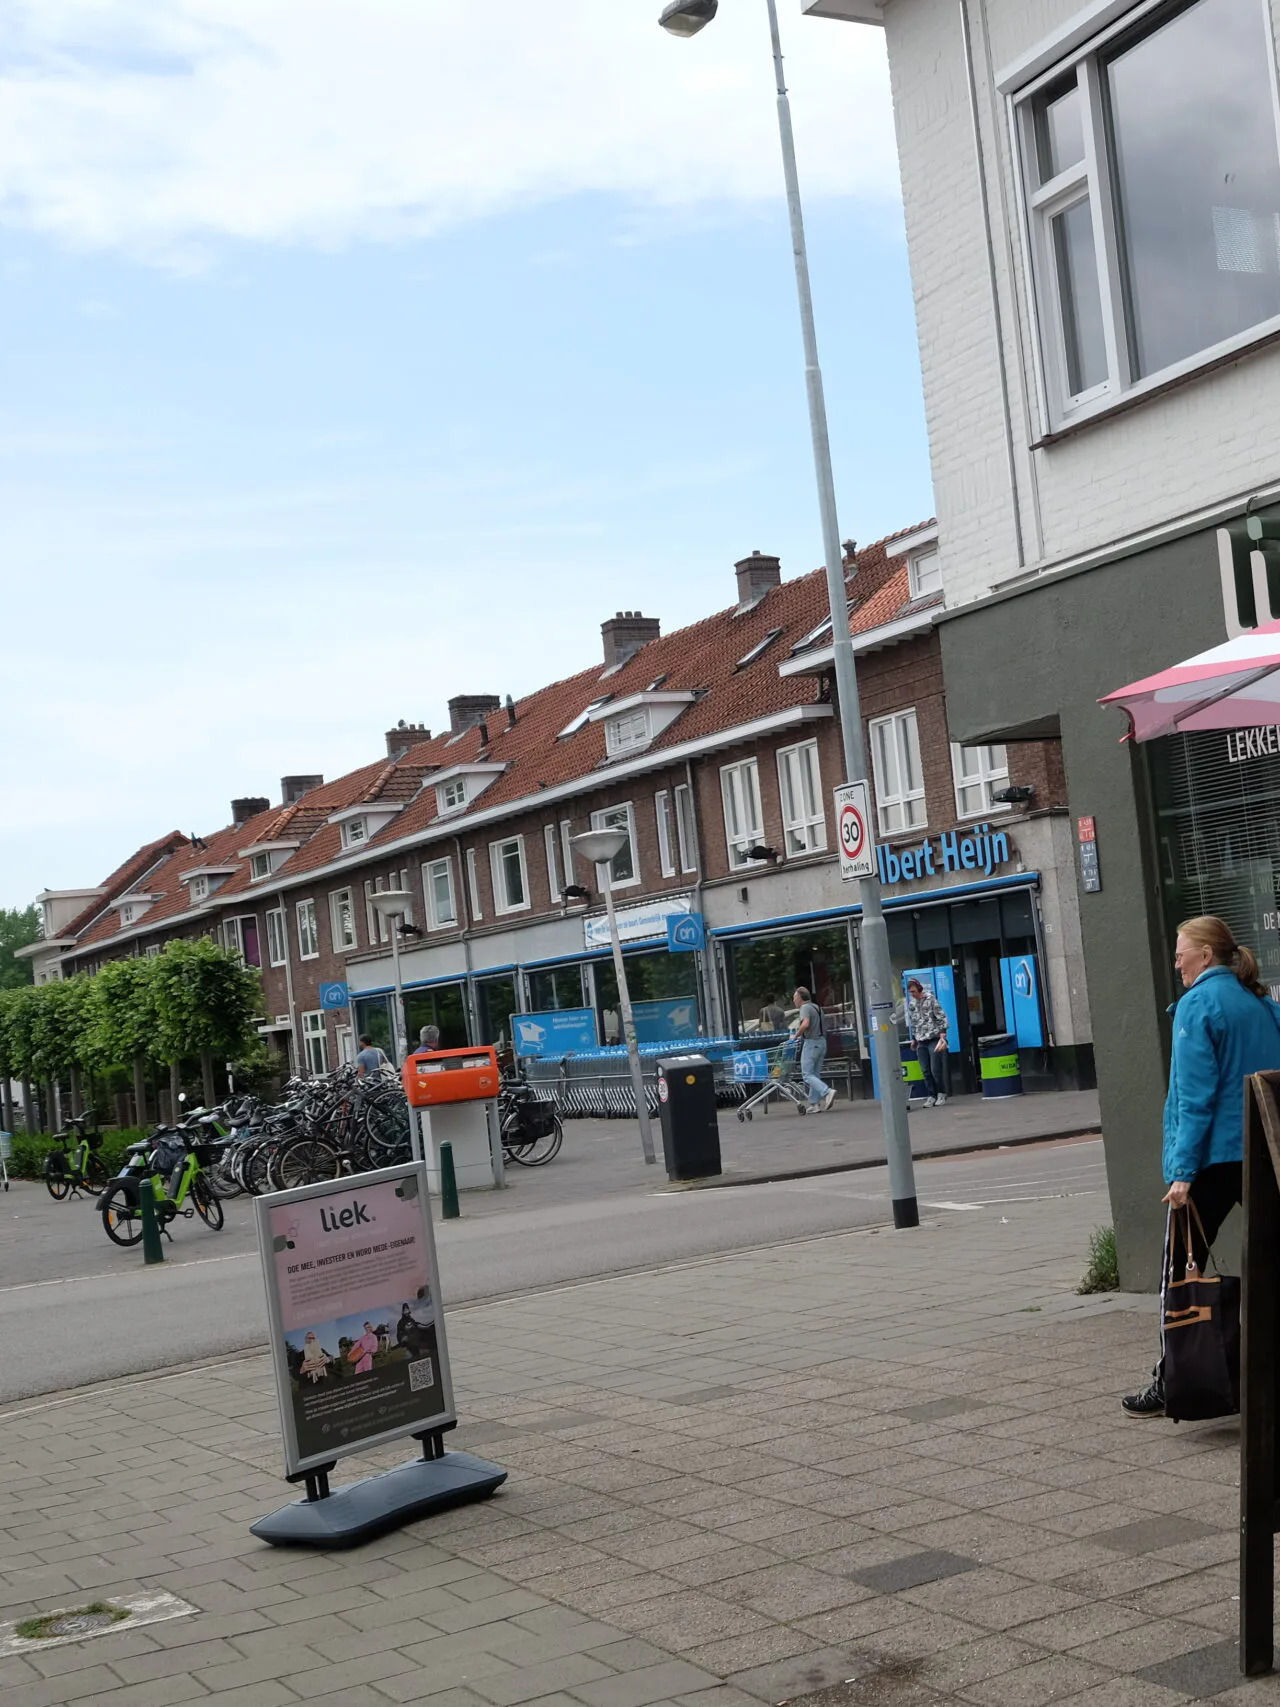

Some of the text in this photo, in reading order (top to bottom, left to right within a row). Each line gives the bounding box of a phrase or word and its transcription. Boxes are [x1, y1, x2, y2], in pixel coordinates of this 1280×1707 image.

[839, 790, 854, 802] ZONE
[843, 821, 859, 844] 30
[876, 823, 1009, 885] lbert Heijn
[1263, 912, 1276, 930] DE
[319, 1200, 377, 1233] liek.
[287, 1265, 300, 1274] DOE
[316, 1253, 346, 1268] INVESTEER
[347, 1252, 355, 1260] EN
[355, 1248, 372, 1258] WORD
